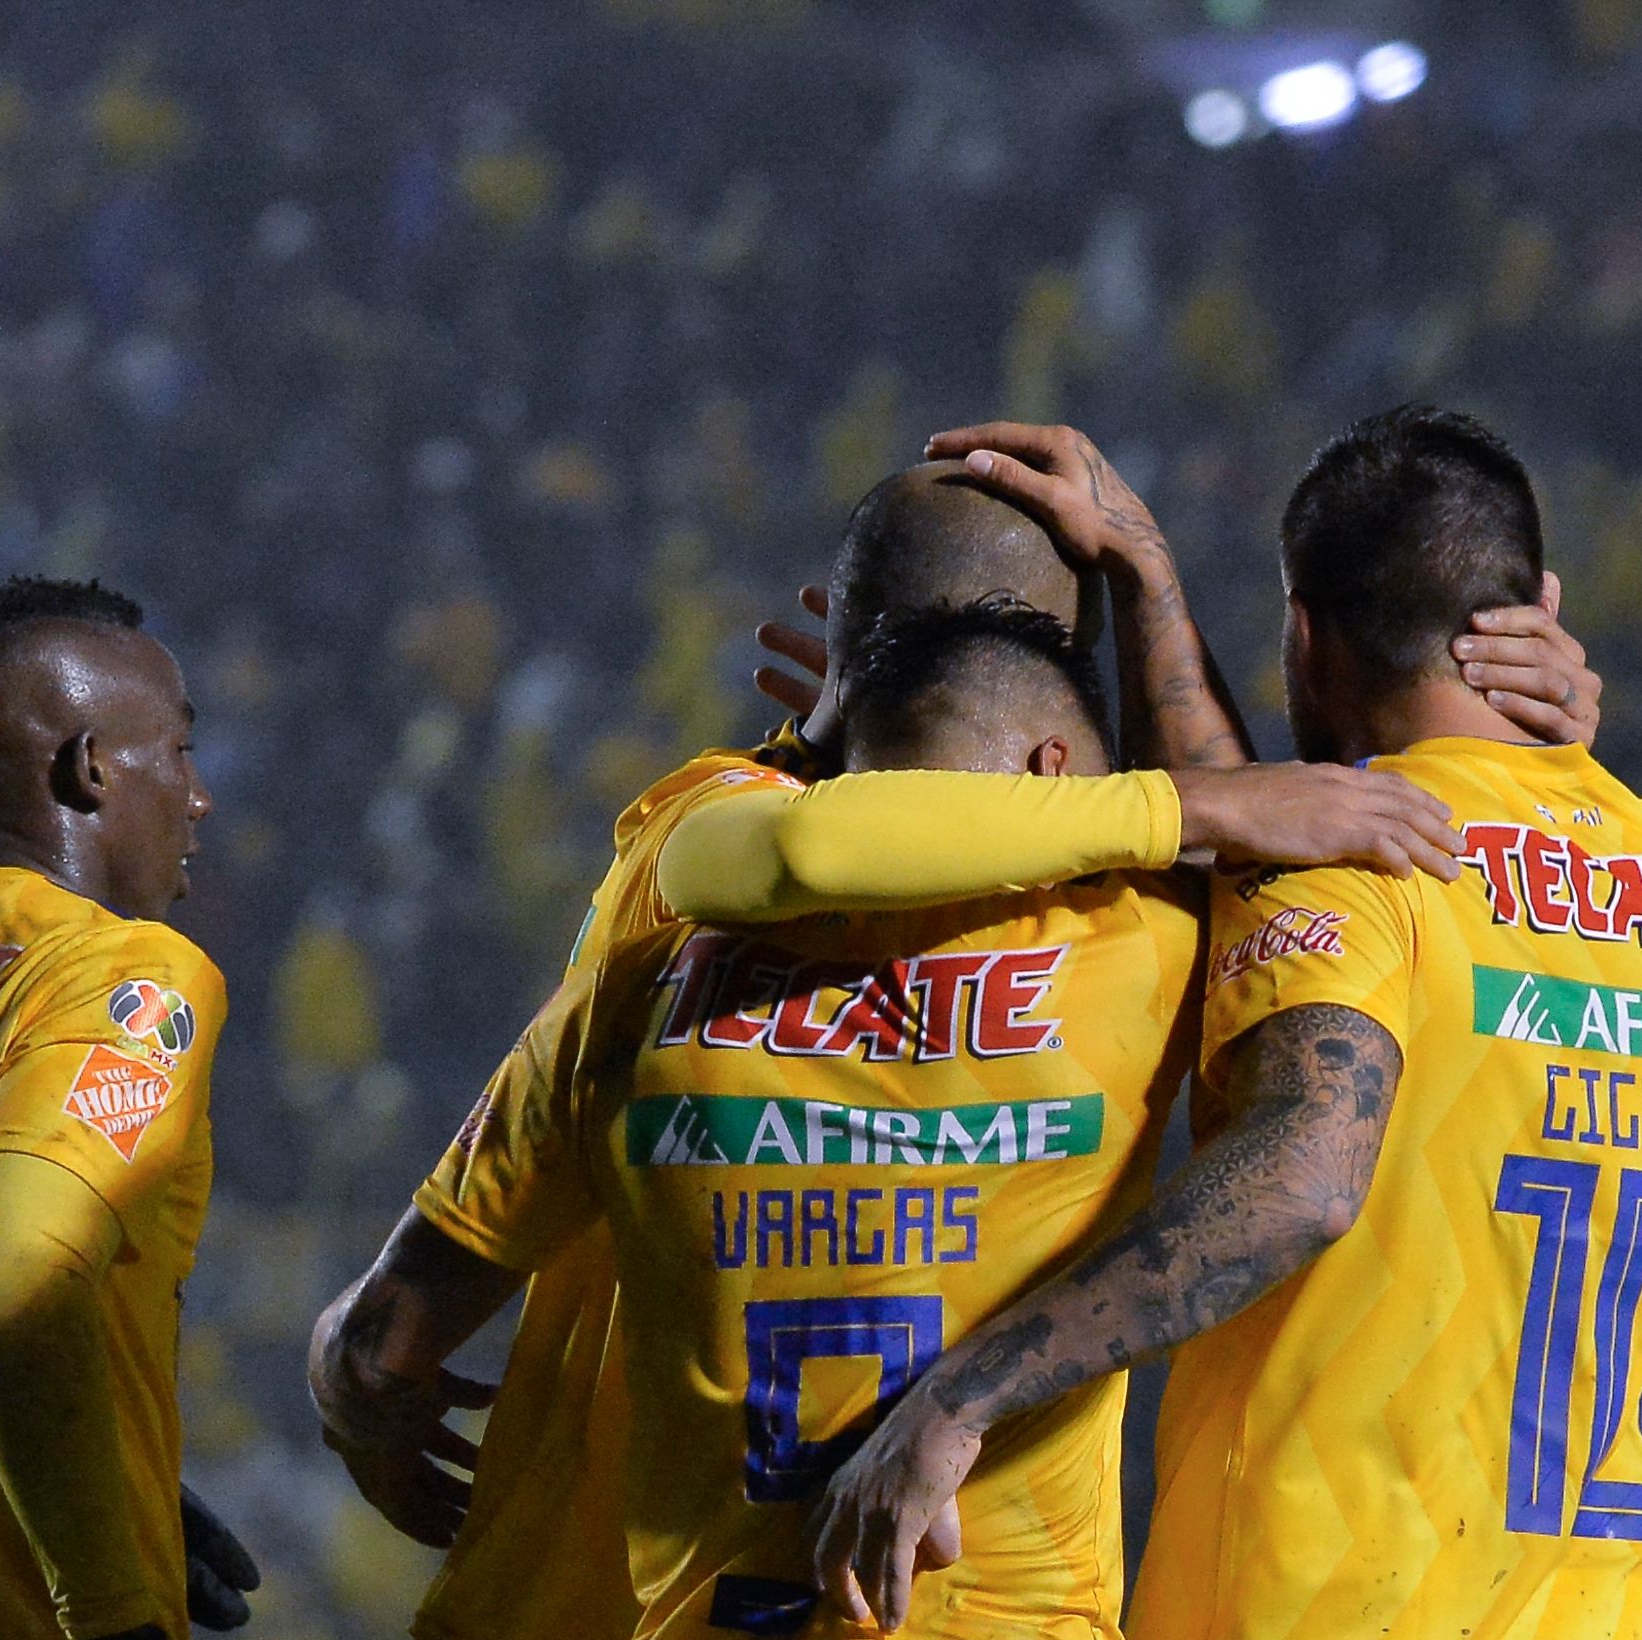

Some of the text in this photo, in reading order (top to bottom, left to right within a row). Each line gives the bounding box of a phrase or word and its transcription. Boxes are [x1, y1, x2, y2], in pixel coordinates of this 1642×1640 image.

[657, 925, 1071, 1063] TECATE
[73, 1077, 164, 1121] HOME
[746, 1098, 1072, 1166] AFIRME
[712, 1185, 979, 1270] VARGAS
